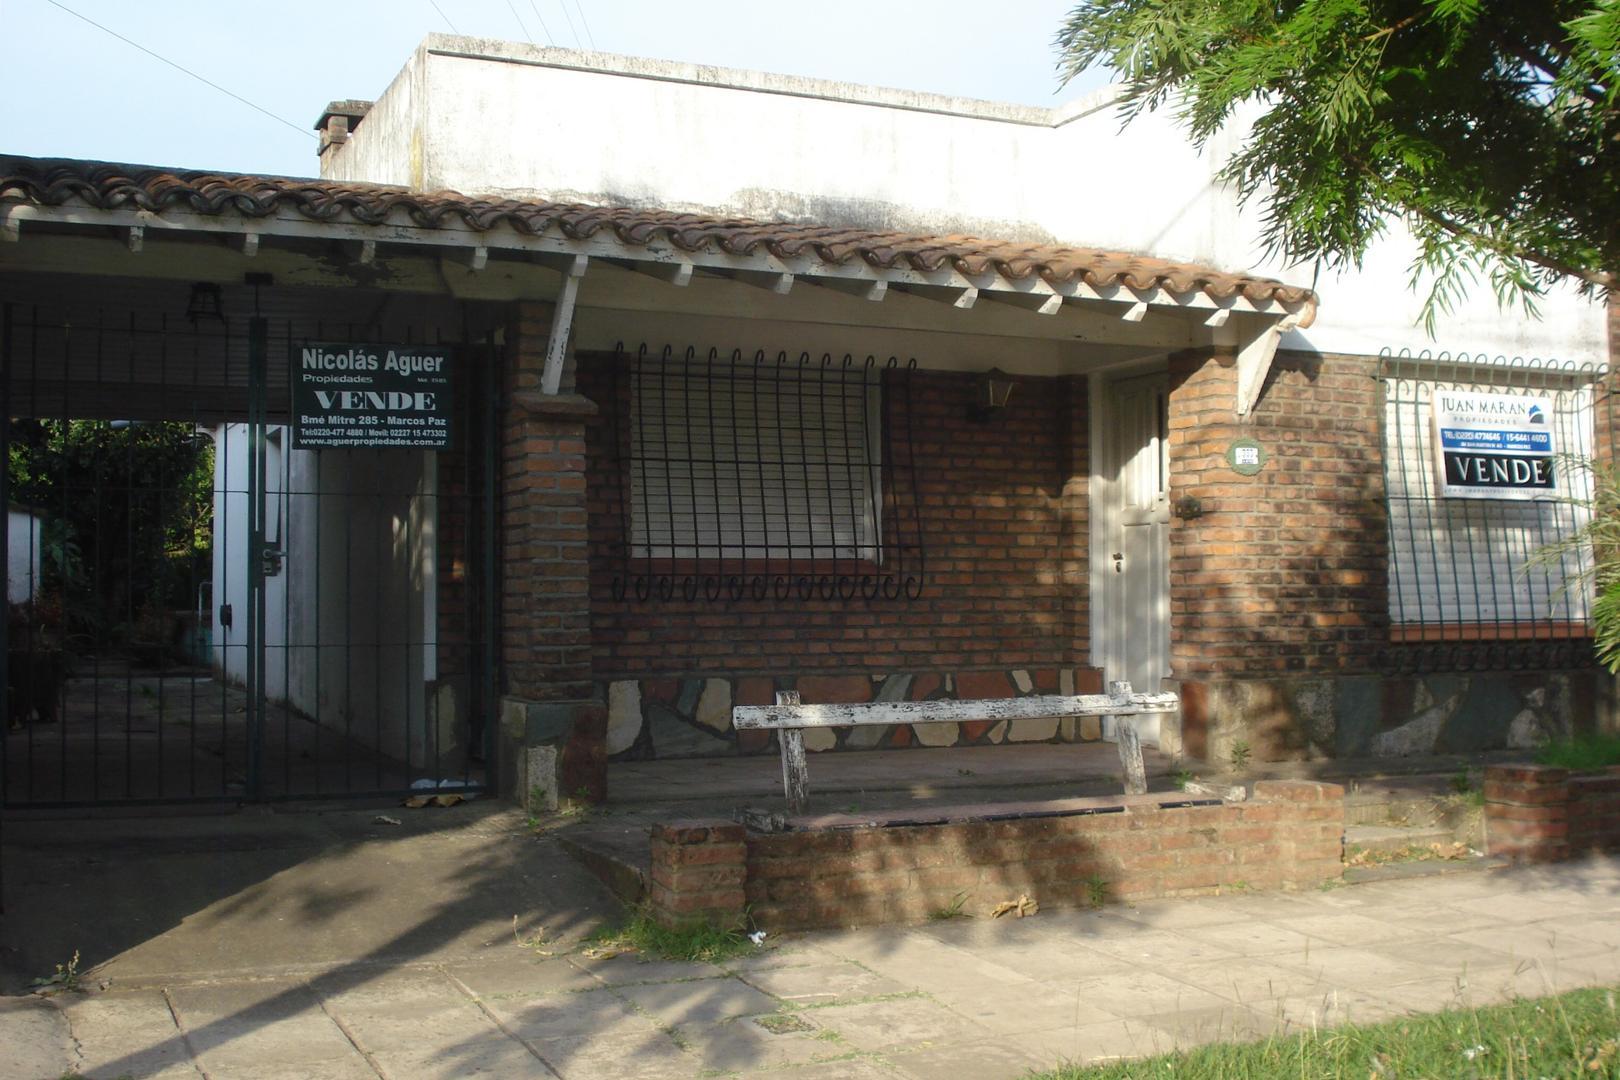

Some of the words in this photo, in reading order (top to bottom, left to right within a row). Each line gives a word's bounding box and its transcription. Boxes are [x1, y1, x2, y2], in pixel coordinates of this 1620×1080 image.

[302, 348, 378, 370] Nicolás
[385, 350, 443, 376] Aguer
[302, 374, 373, 383] Propiedades
[313, 391, 436, 410] VENDE
[1442, 398, 1474, 413] JUAN
[1479, 400, 1525, 415] MARAN
[301, 415, 325, 424] Bmé
[328, 415, 355, 424] Mitre
[358, 416, 378, 425] 285
[387, 416, 425, 425] Marcos
[428, 417, 446, 426] Paz
[299, 437, 446, 447] www.aguerpropiedades.com.ar
[1455, 456, 1546, 484] VENDE
